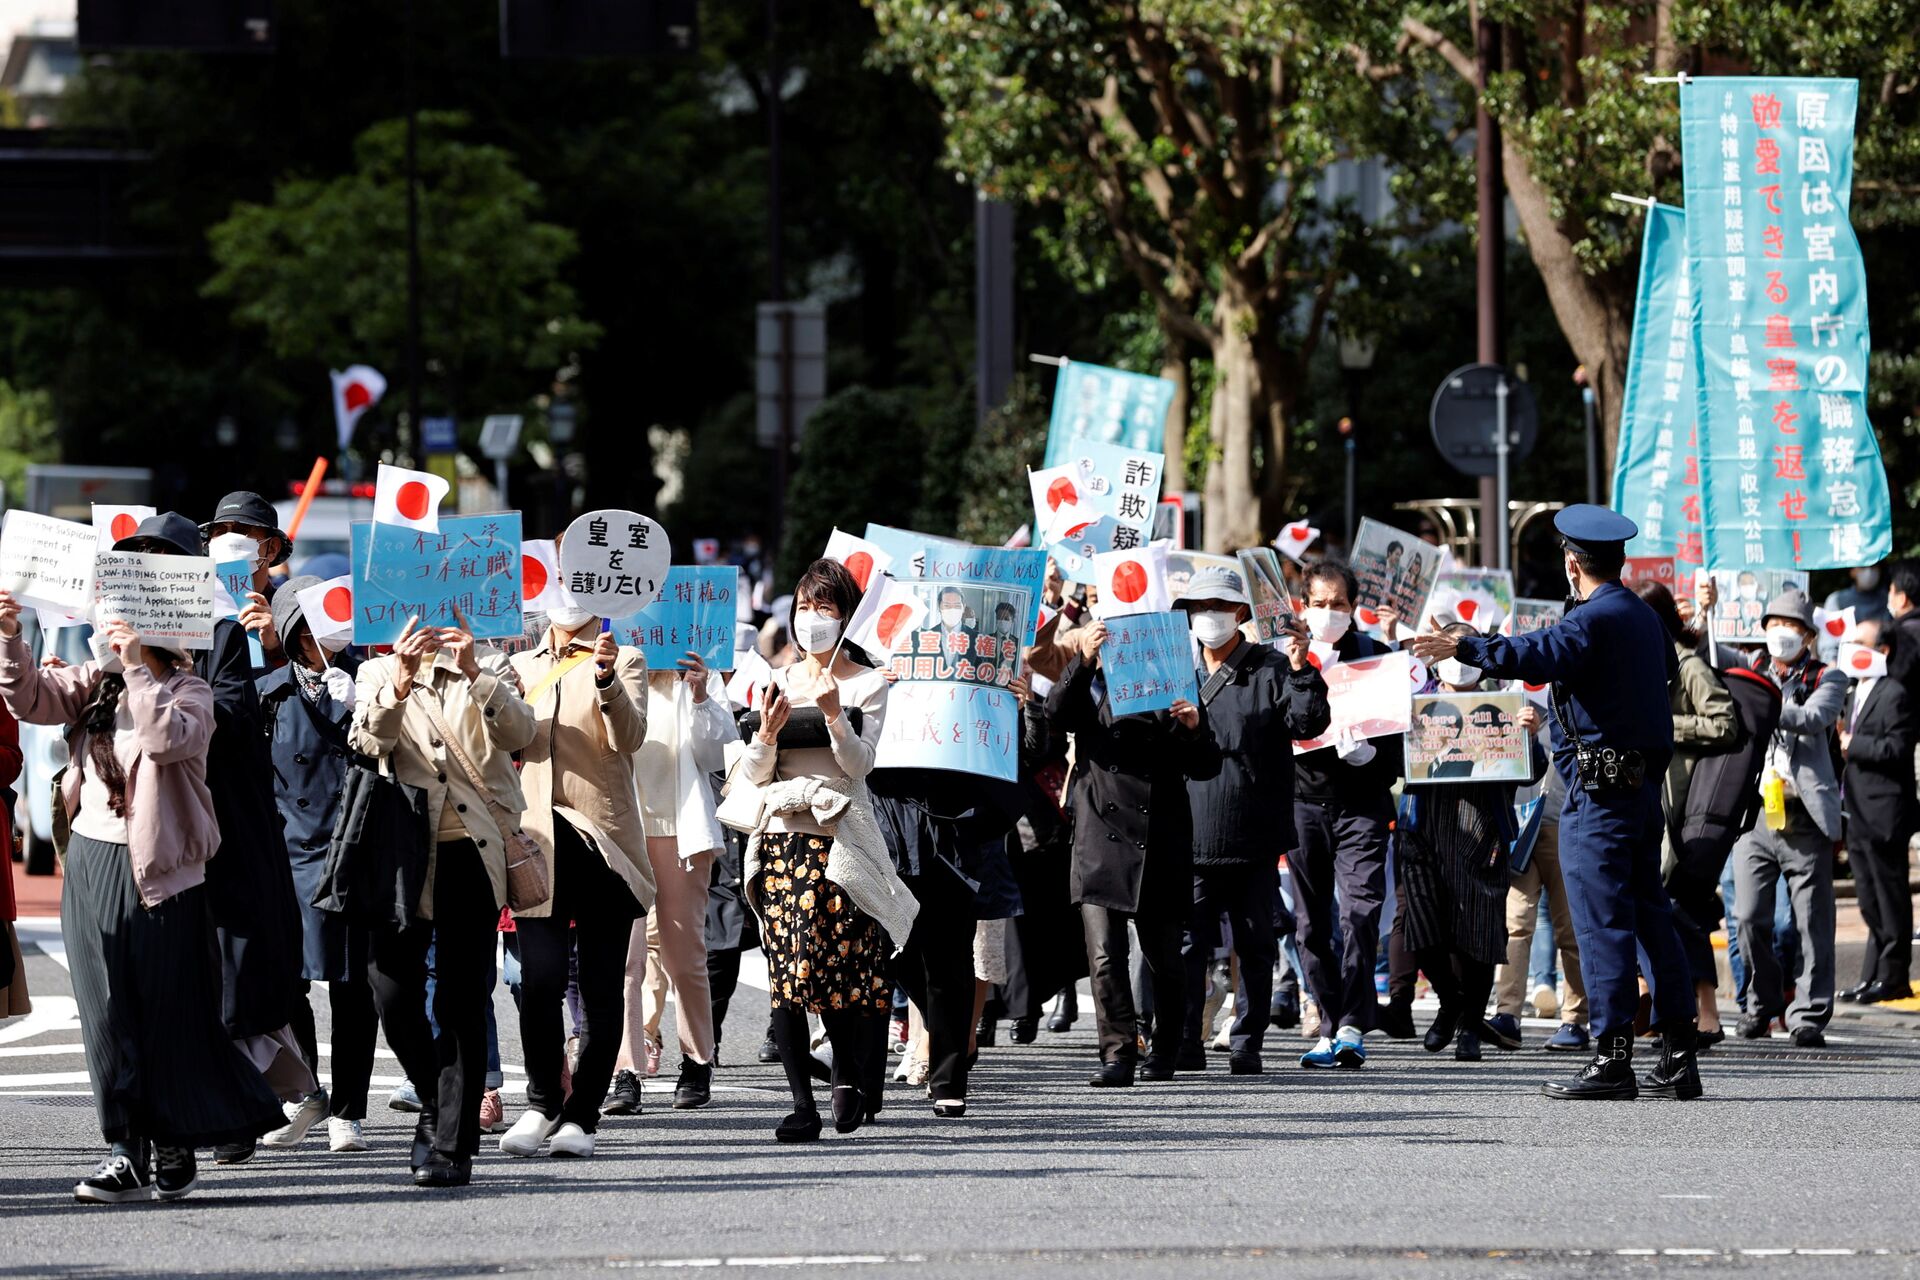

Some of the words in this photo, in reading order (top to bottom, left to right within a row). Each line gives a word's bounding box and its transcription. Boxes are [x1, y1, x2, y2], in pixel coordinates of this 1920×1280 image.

[1796, 92, 1862, 562] 原因は宮内庁の職務怠慢
[412, 522, 500, 555] 不正入学
[588, 516, 649, 549] 皇室
[95, 554, 124, 566] Japan
[415, 550, 513, 582] コネ就職
[609, 550, 624, 571] を
[932, 560, 1004, 579] KOMURO
[1013, 562, 1041, 579] WAS
[97, 568, 157, 580] LAW-ABIDING
[571, 571, 655, 596] 護りたい
[139, 583, 167, 593] Pension
[170, 584, 195, 593] Fraud
[891, 656, 1014, 686] 利用したのか
